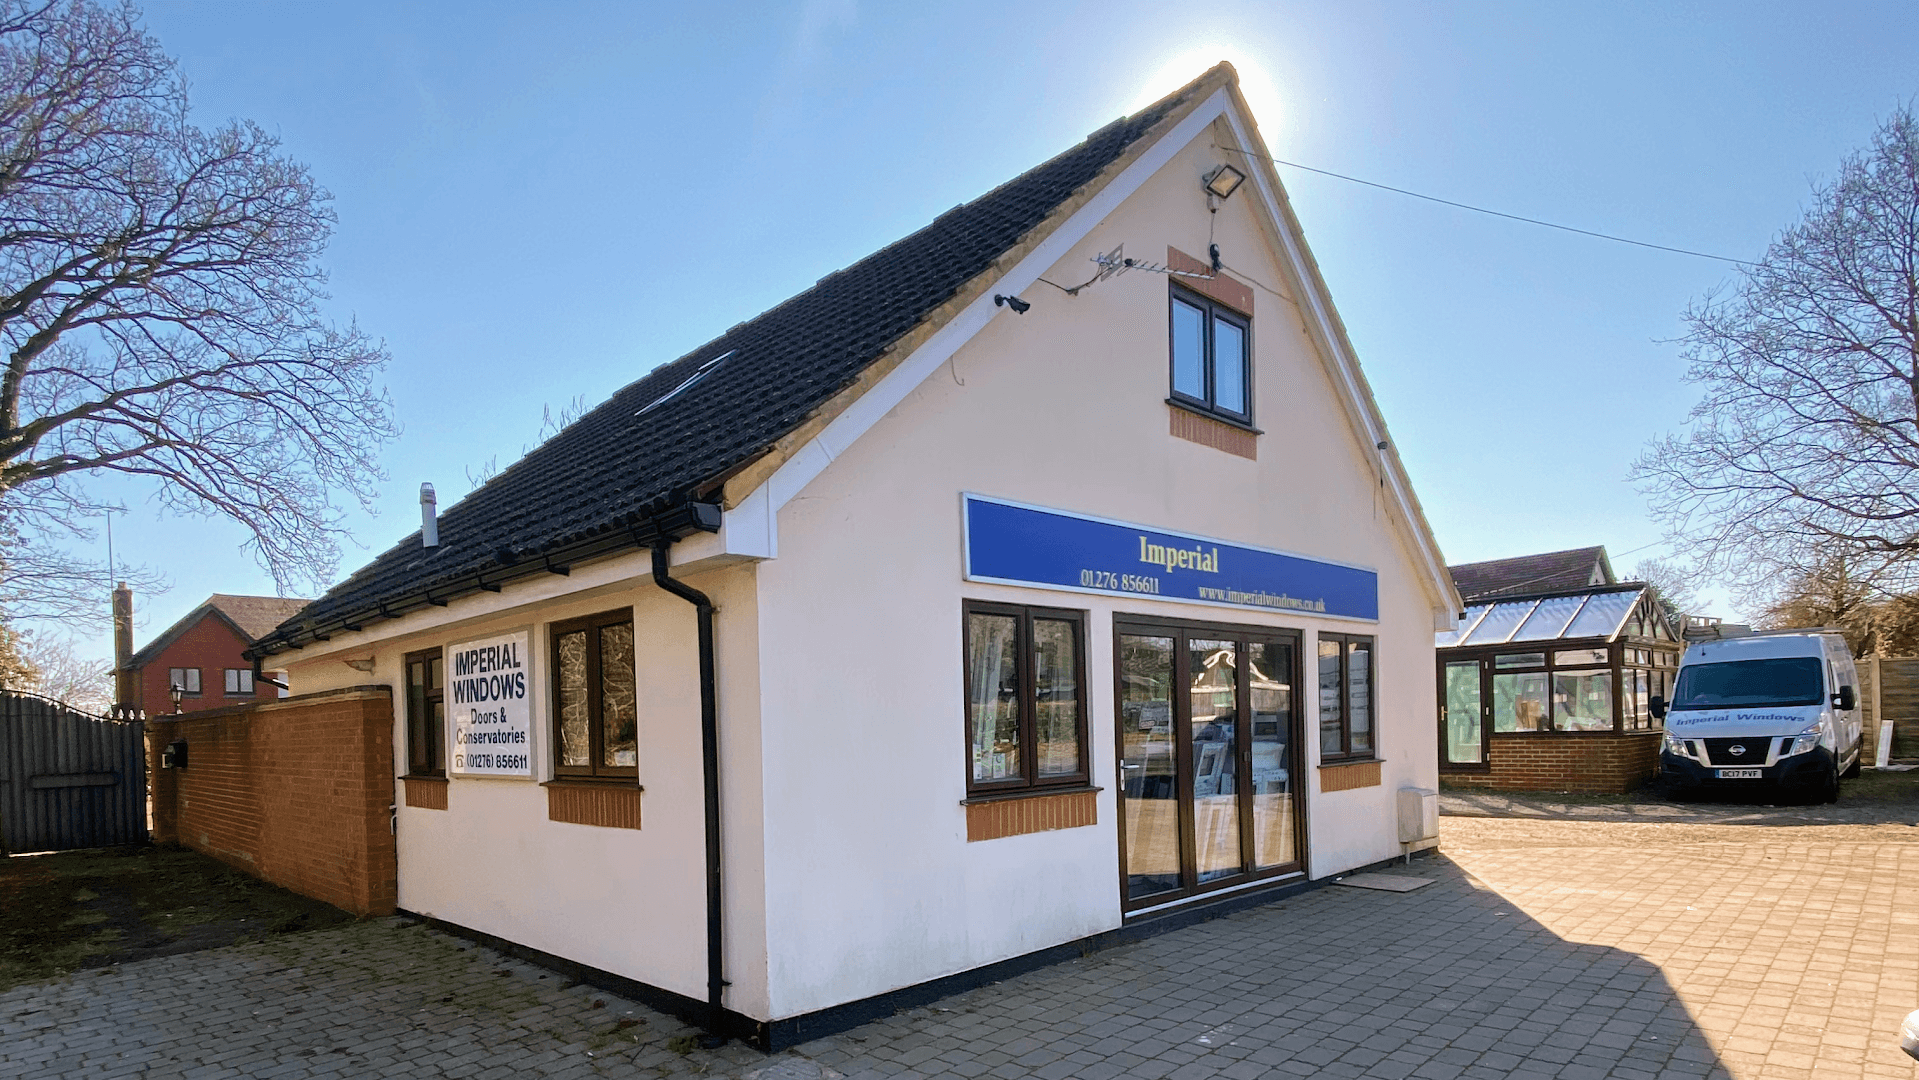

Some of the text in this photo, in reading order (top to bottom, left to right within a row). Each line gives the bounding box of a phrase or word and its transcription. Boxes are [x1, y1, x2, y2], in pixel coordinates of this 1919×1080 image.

[1139, 536, 1218, 573] Imperial
[1080, 569, 1159, 594] 01276 856611
[1198, 586, 1326, 612] www.imperialwindows.co.uk
[455, 642, 521, 676] IMPERIAL
[453, 672, 526, 704] WINDOWS
[471, 707, 507, 724] Doors &
[1676, 713, 1805, 726] Imperial Windows
[456, 726, 526, 745] Conservatories
[467, 753, 528, 769] (01276) 856611
